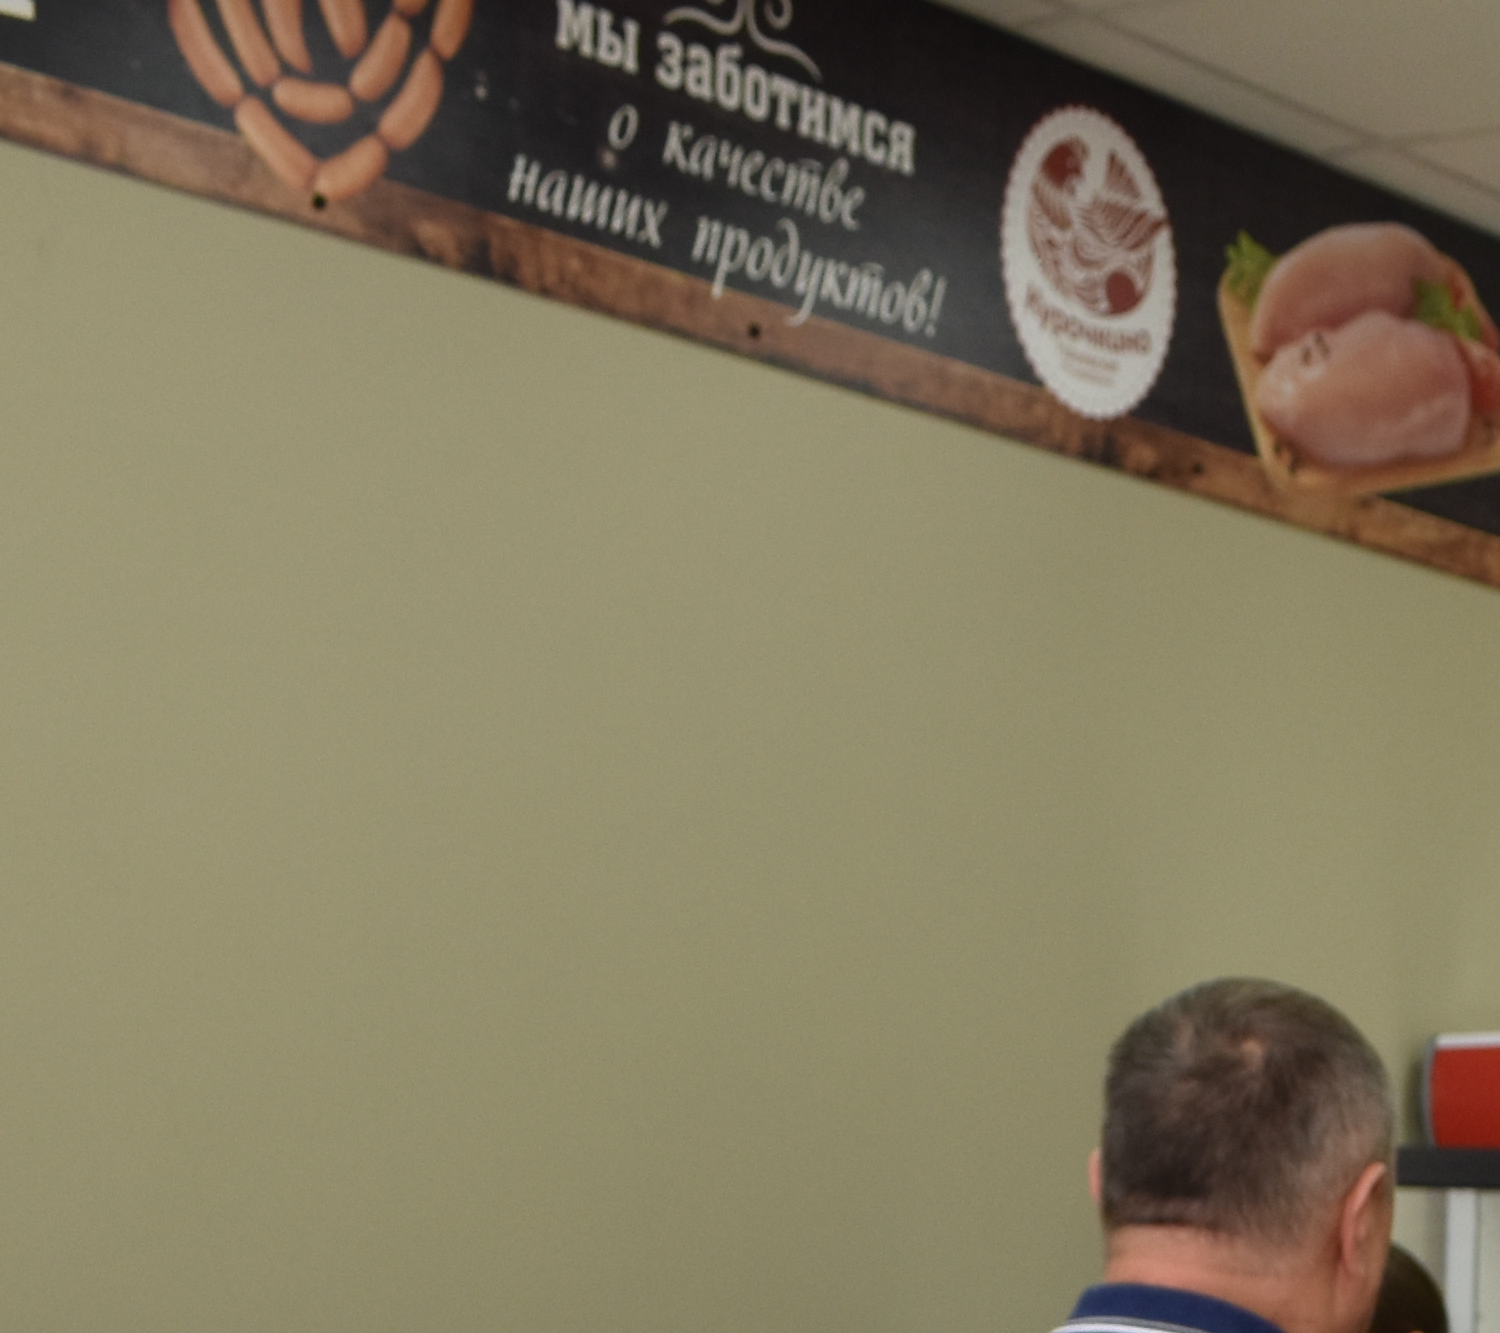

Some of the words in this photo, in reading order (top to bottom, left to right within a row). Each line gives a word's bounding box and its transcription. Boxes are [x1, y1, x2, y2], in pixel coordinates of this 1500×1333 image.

[507, 153, 668, 249] наших
[691, 217, 948, 338] продуктов!
[663, 120, 866, 230] качестве
